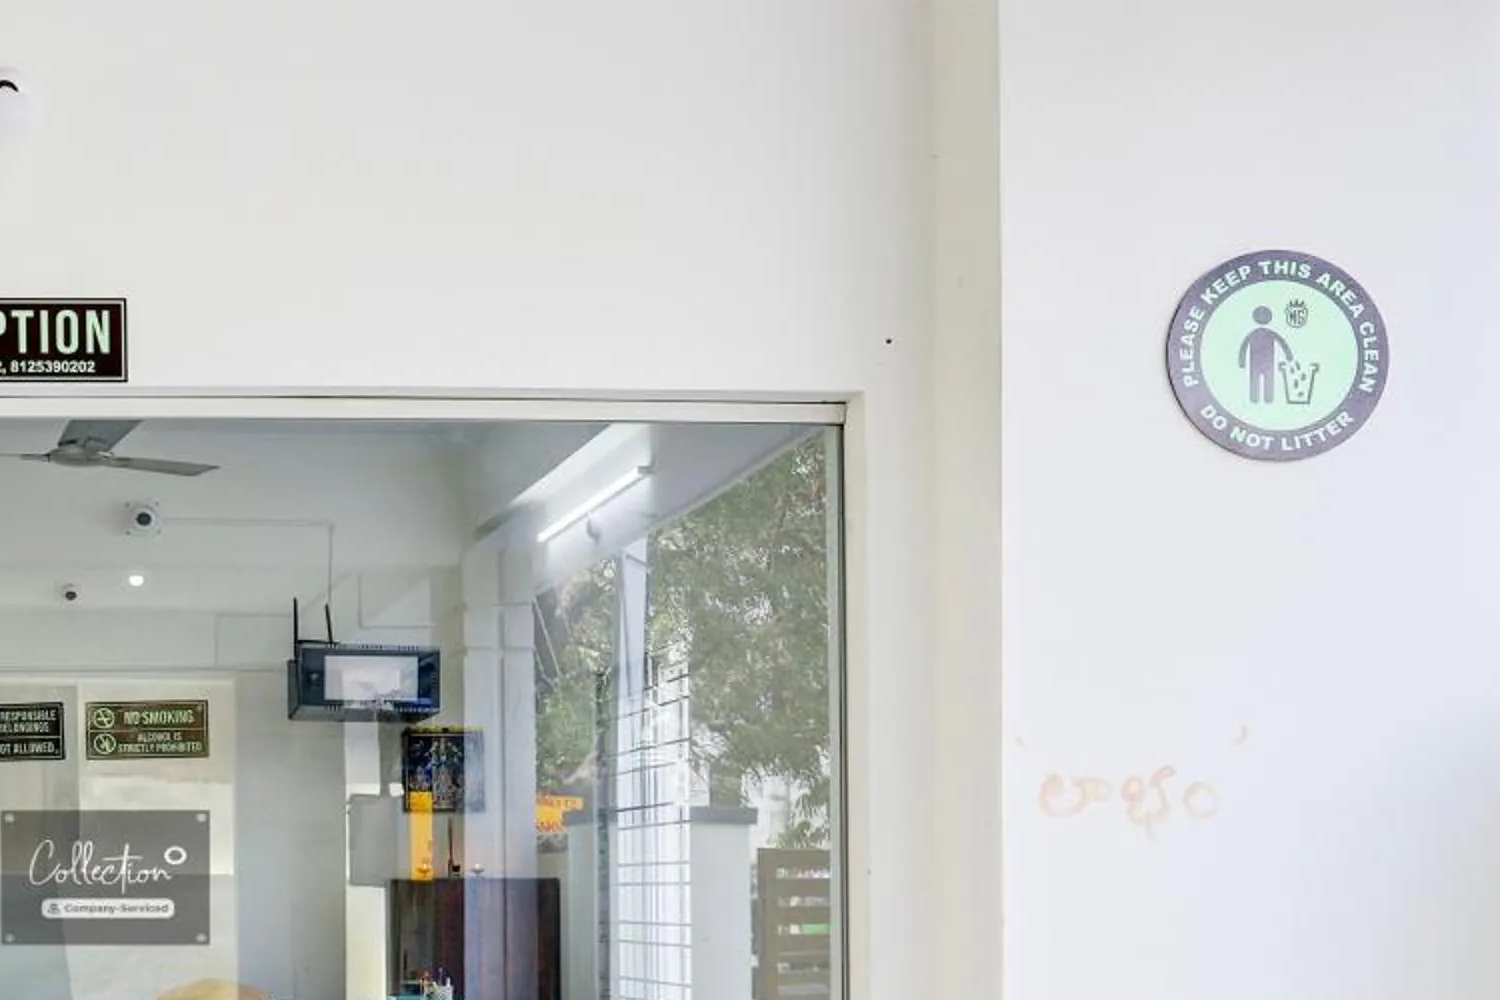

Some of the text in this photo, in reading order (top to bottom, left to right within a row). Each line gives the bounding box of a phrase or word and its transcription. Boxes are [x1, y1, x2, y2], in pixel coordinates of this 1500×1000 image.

[1180, 260, 1379, 393] PLEASE KEEP THIS AREA CLEAN
[10, 360, 96, 373] 8125390202
[1201, 404, 1355, 450] DO NOT LITTER
[124, 710, 195, 725] NO SMOKING
[28, 839, 174, 895] Collection
[63, 903, 169, 915] Company-Serviced
